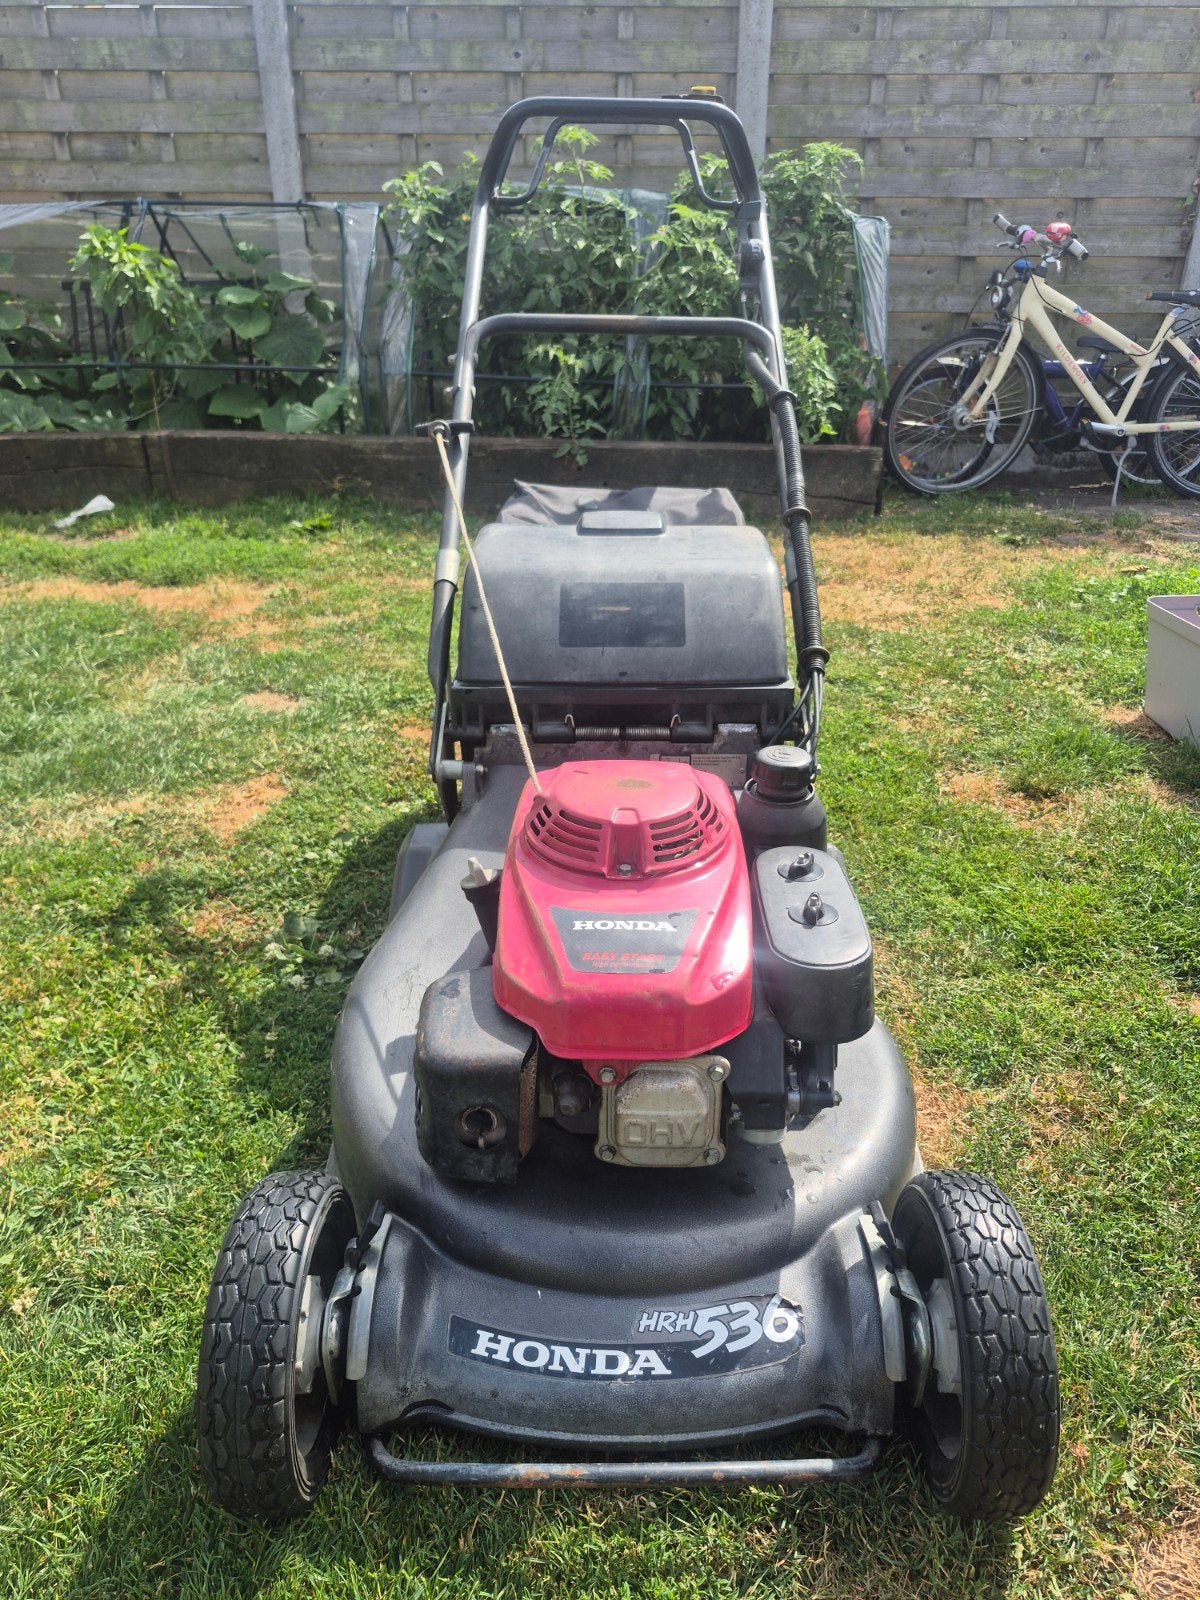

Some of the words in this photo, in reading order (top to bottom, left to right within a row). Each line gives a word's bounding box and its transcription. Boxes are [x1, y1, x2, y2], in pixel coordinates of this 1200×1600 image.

[572, 920, 677, 932] HONDA
[624, 1118, 700, 1145] OHV
[471, 1329, 672, 1376] HONDA
